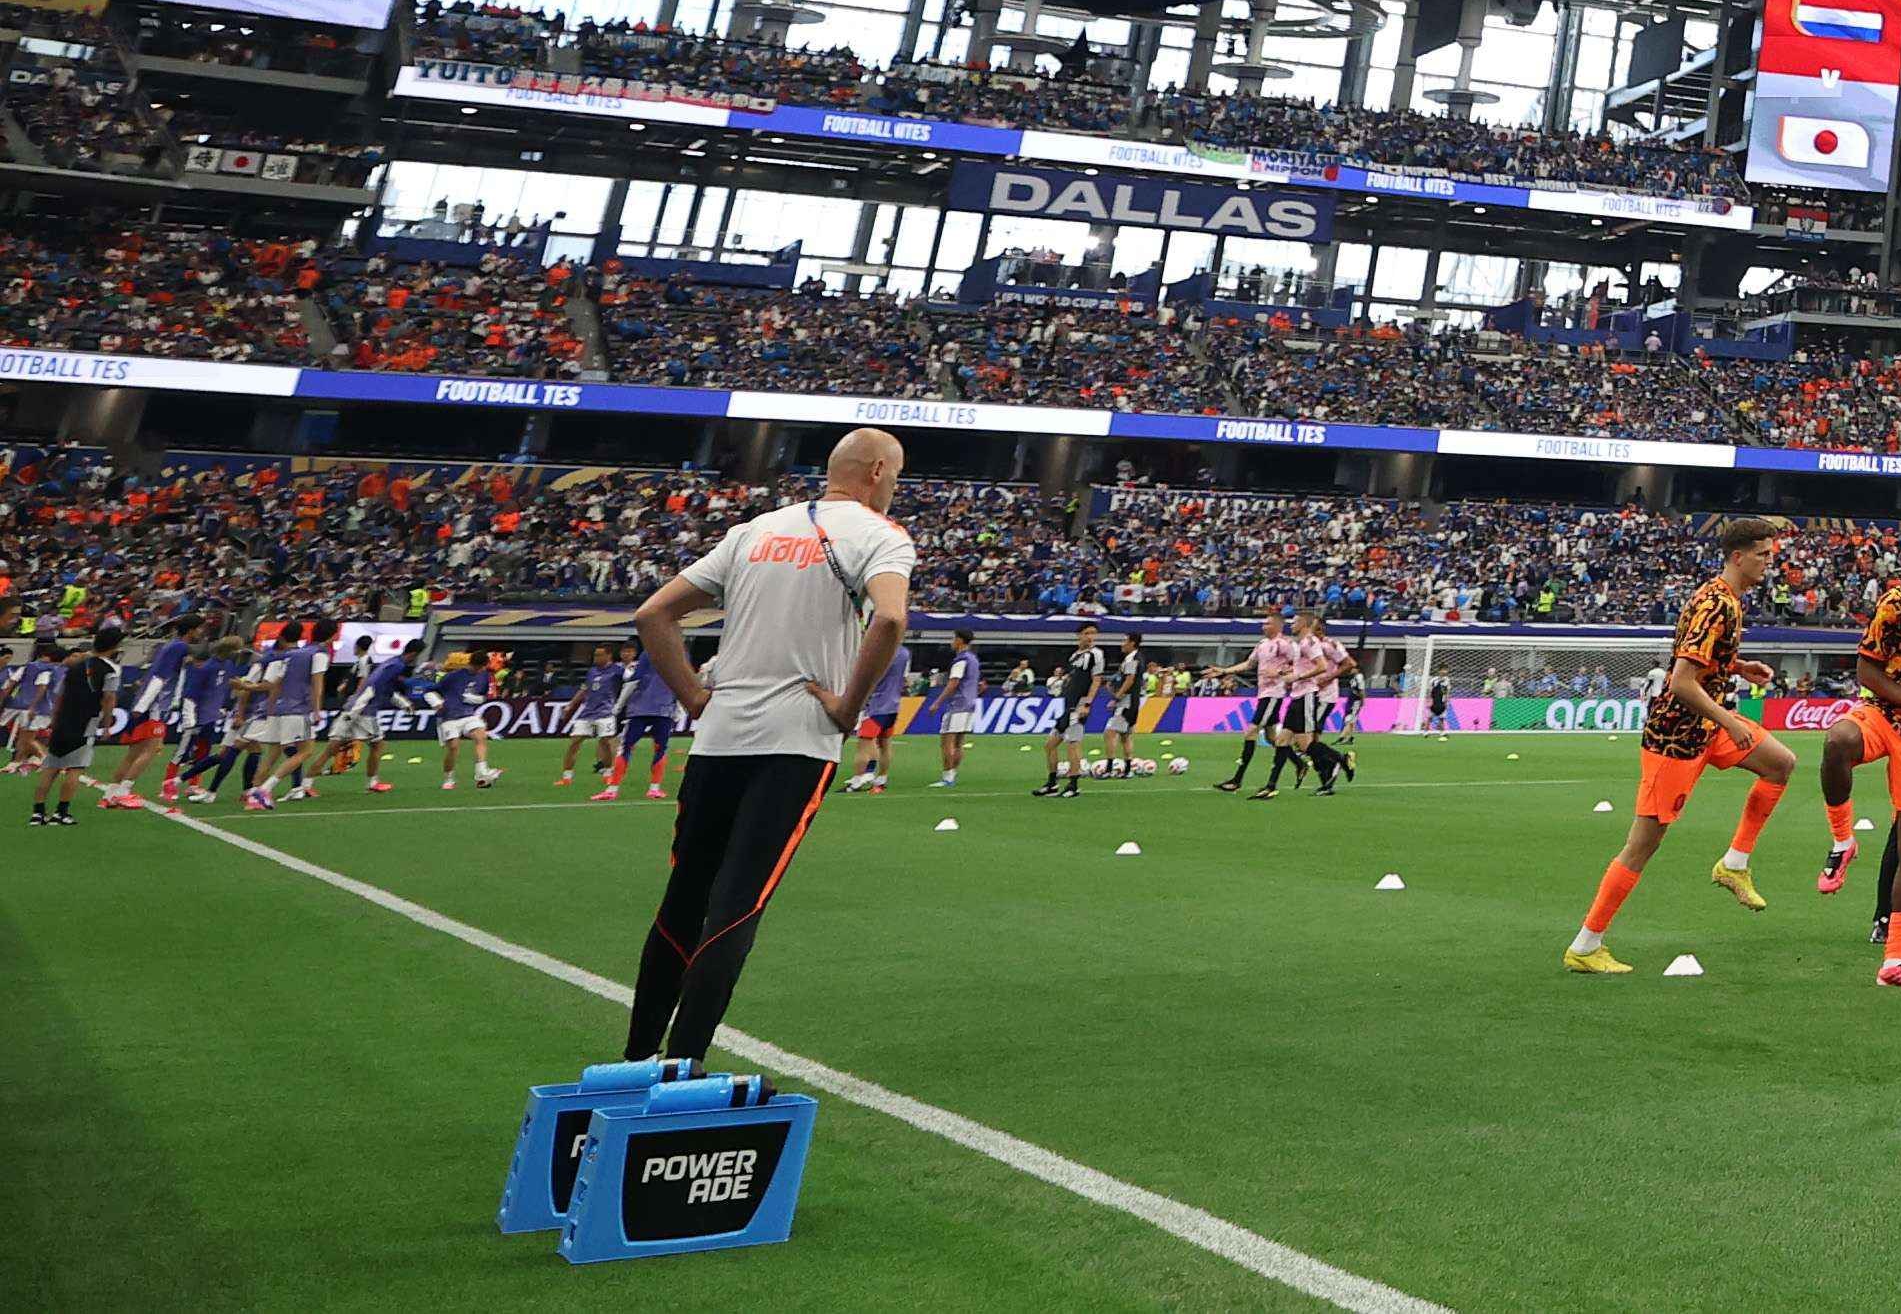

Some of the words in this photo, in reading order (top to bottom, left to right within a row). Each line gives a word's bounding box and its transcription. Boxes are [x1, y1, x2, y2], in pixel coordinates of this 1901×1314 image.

[823, 114, 890, 139] FOOTBALL
[1108, 145, 1169, 167] FOOTBALL
[1264, 164, 1322, 177] NIPPON
[1365, 172, 1423, 193] FOOTBALL
[989, 171, 1319, 239] DALLAS
[1602, 198, 1651, 215] FOOTBALL
[1024, 294, 1071, 307] WOLD
[436, 380, 538, 404] FOOTBALL
[856, 402, 943, 423] FOOTBALL
[1217, 421, 1293, 442] FOOTBALL
[1536, 438, 1605, 458] FOOTBALL
[1818, 453, 1880, 471] FOOTBALL
[972, 697, 1066, 734] VISA
[641, 1149, 758, 1184] POWER
[687, 1174, 753, 1204] ADE
